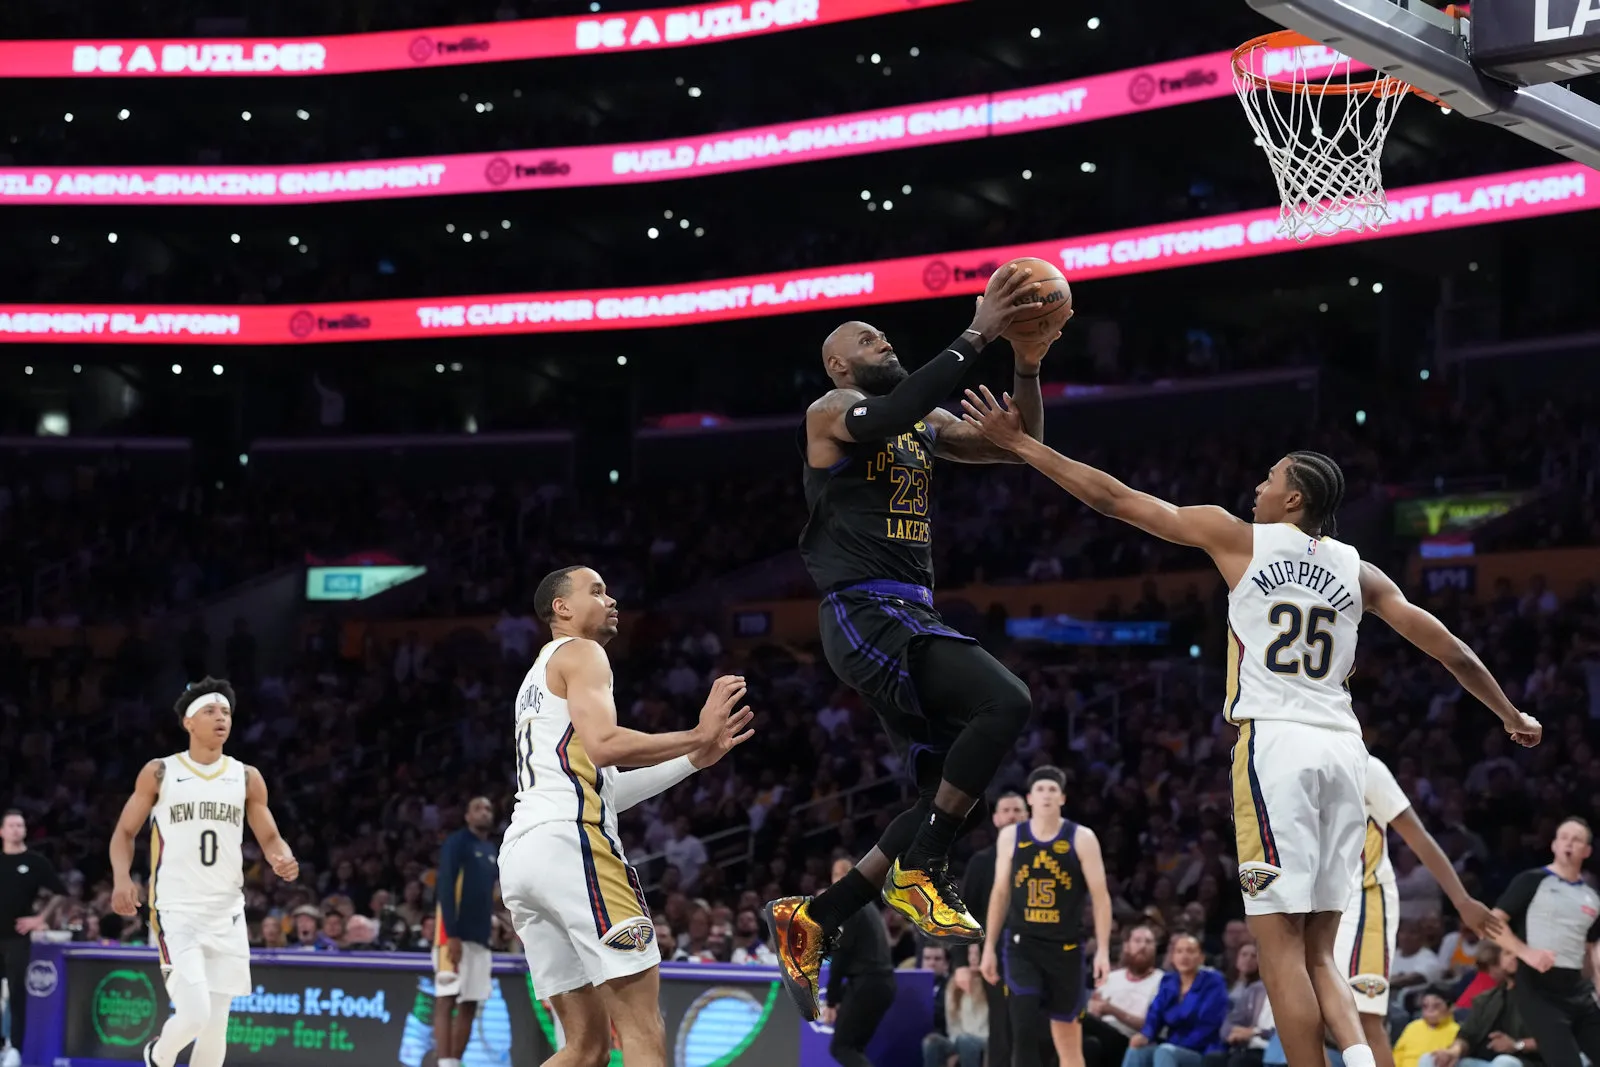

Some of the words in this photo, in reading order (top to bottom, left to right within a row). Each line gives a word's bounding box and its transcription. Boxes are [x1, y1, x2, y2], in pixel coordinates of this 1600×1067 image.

[576, 19, 626, 49] BE
[630, 16, 660, 45] A
[665, 0, 819, 42] BUILDER
[73, 46, 123, 72] BE
[127, 46, 156, 72] A
[162, 43, 326, 72] BUILDER
[612, 145, 695, 174] BUILD
[697, 116, 905, 165] ARENA-SHAKING
[908, 87, 1087, 135] ENGAGEMENT
[56, 173, 277, 195] ARENA-SHAKING
[278, 164, 446, 195] ENGAGEMENT
[1061, 243, 1109, 270] THE
[1112, 224, 1244, 263] CUSTOMER
[1432, 173, 1585, 217] PLATFORM
[417, 305, 465, 327] THE
[466, 299, 593, 325] CUSTOMER
[595, 287, 750, 319] ENGAGEMENT
[752, 272, 874, 306] PLATFORM
[0, 313, 109, 333] AGEMENT
[110, 313, 239, 334] PLATFORM
[866, 443, 896, 481] LOS
[889, 466, 929, 516] 23
[887, 518, 929, 542] LAKERS
[1252, 560, 1336, 596] MURPHY
[1327, 584, 1354, 612] III
[1264, 601, 1338, 680] 25
[169, 802, 195, 824] NEW
[199, 801, 241, 827] ORLEANS
[199, 829, 219, 867] 0
[1027, 878, 1057, 907] 15
[304, 987, 391, 1023] K-Food,
[293, 1020, 327, 1049] for
[329, 1022, 355, 1051] it.
